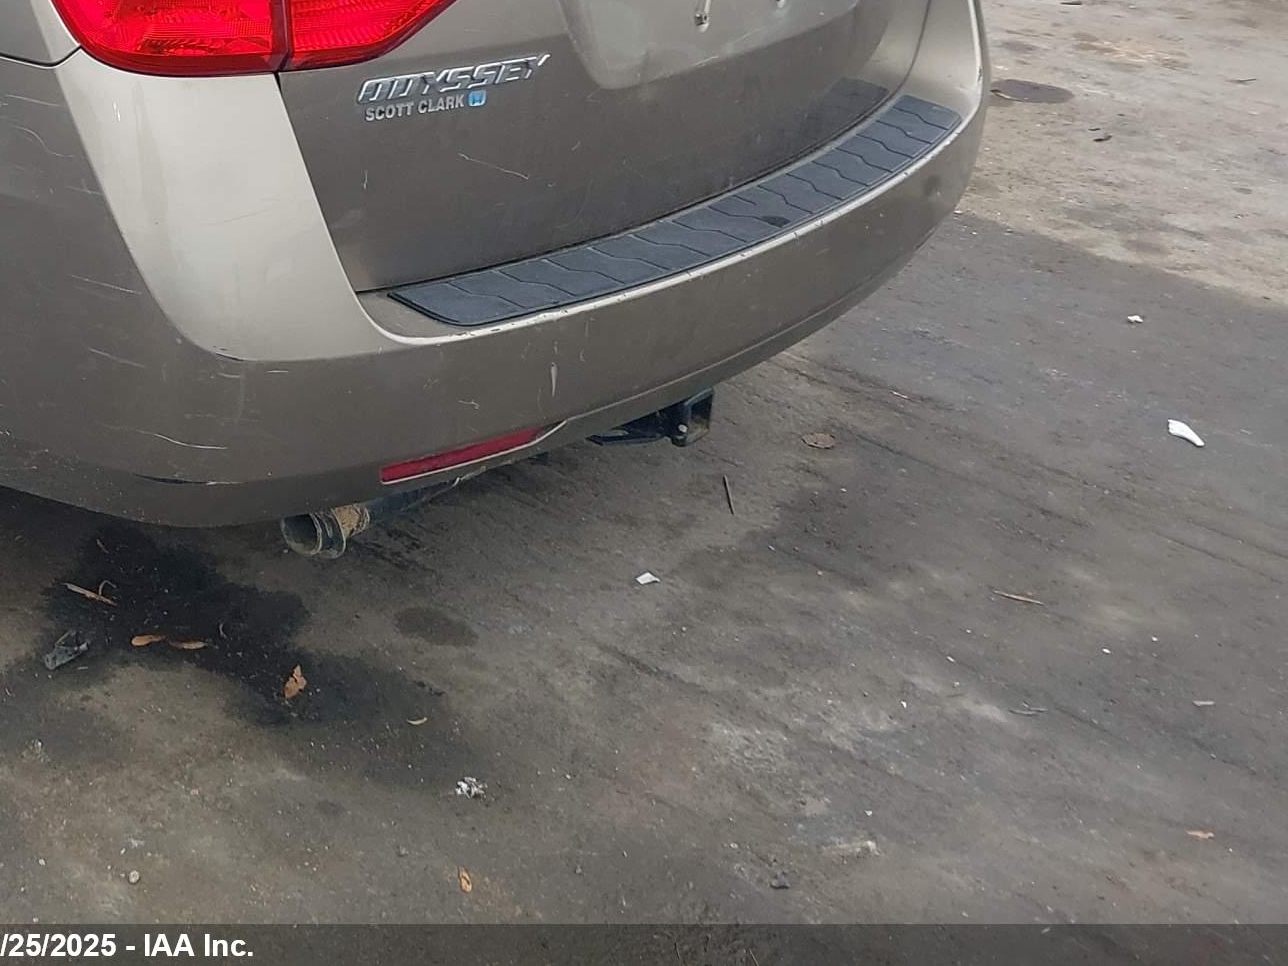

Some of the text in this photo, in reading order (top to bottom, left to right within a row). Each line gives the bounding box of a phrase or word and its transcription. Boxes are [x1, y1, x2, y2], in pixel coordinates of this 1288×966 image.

[358, 53, 551, 102] ODYSSEY
[365, 94, 465, 122] SCOTT CLARK
